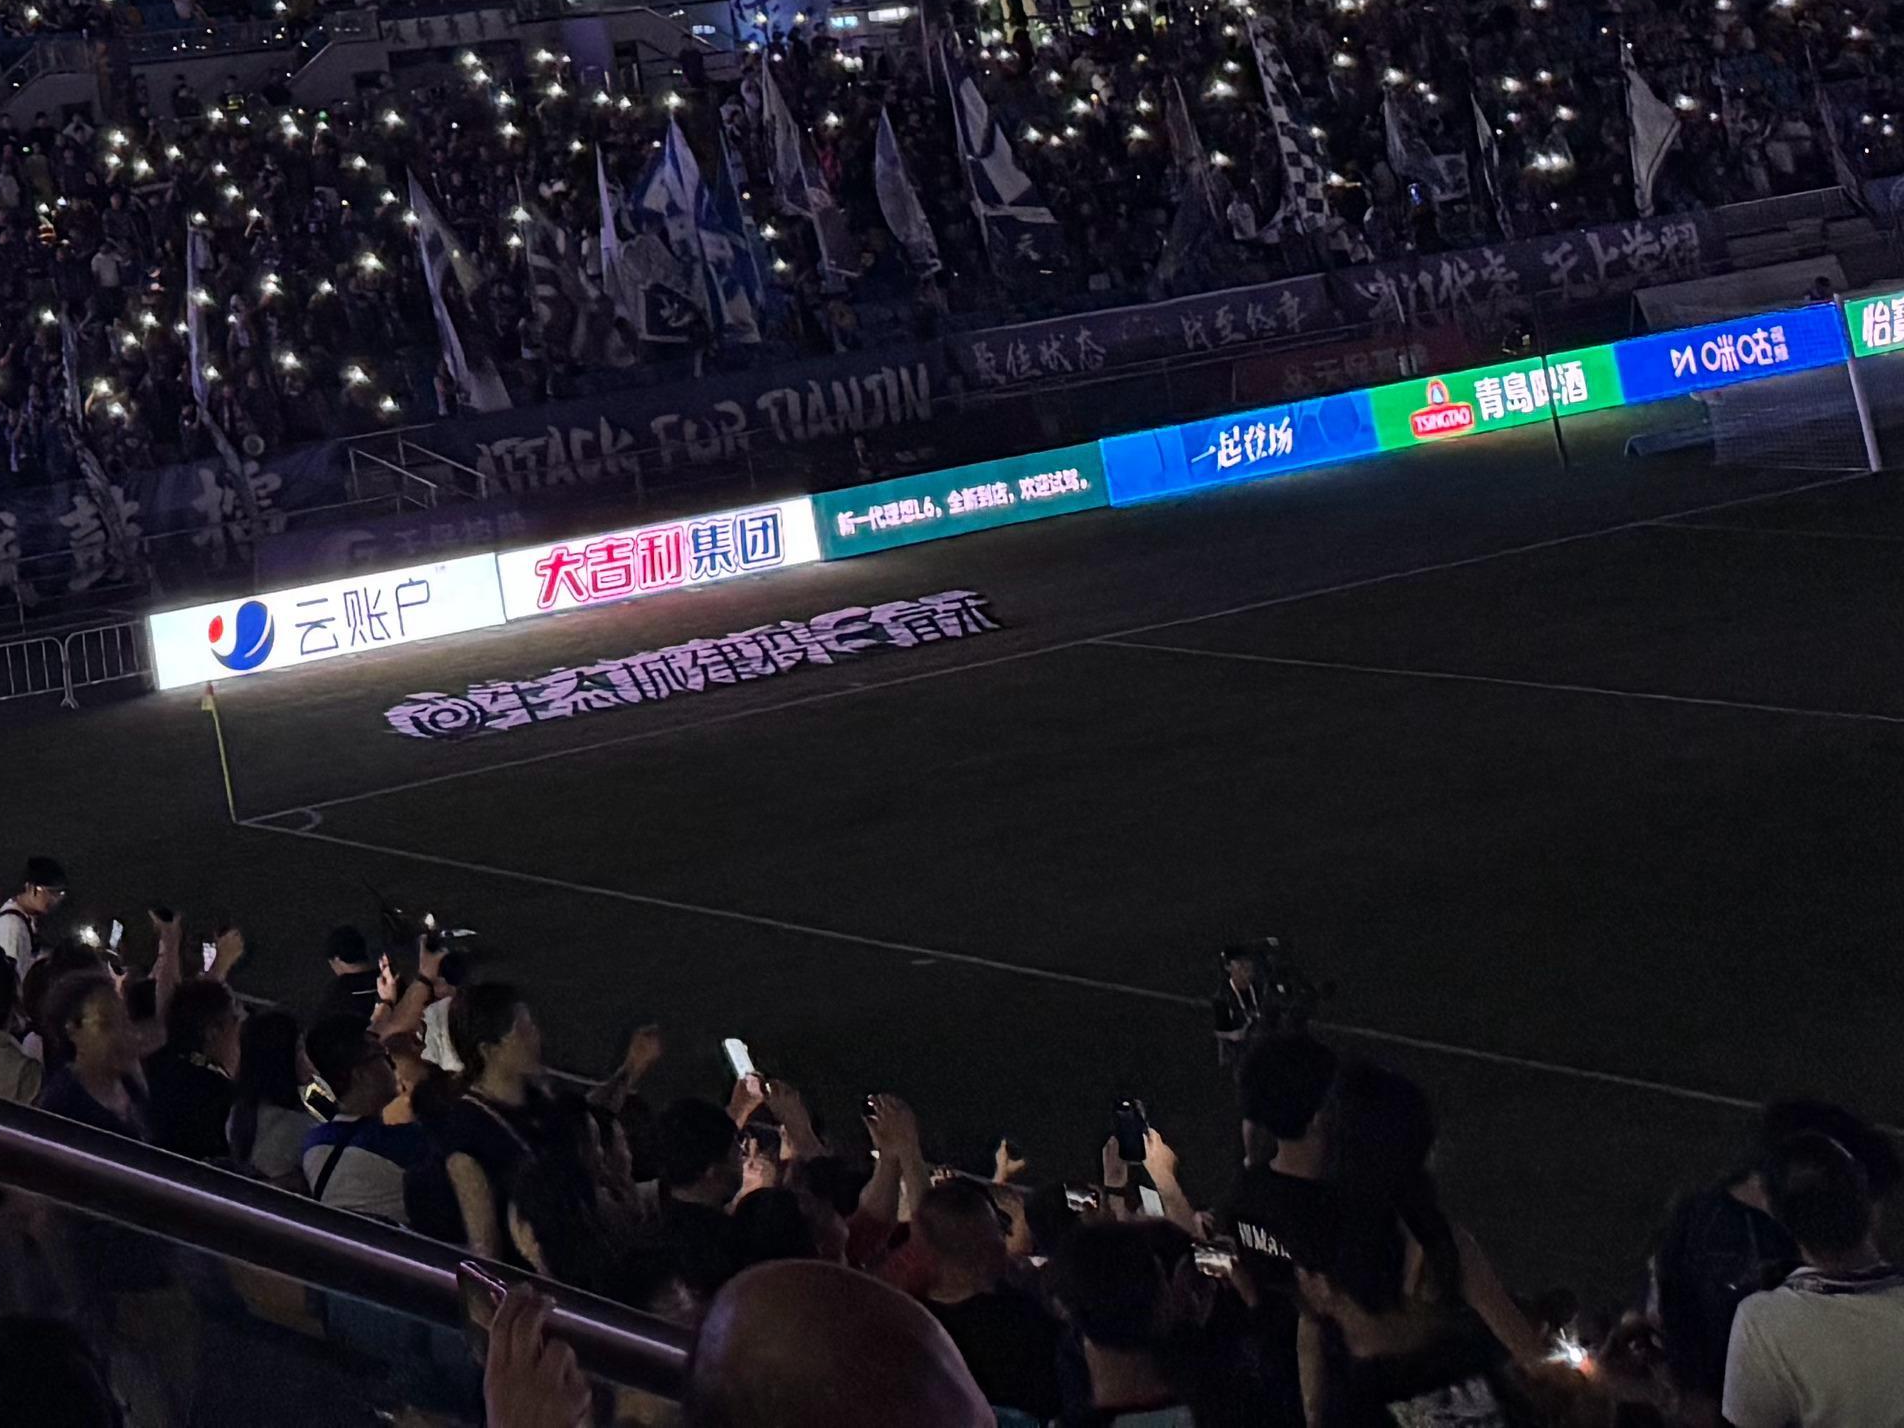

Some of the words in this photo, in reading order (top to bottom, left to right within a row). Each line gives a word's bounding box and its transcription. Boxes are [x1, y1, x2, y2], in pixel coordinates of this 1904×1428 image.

[650, 401, 751, 466] FOR
[758, 363, 932, 443] TIANJIN
[1414, 409, 1470, 433] TSINGTAO
[1474, 361, 1588, 421] 青岛啤酒
[537, 506, 784, 610] 大吉利集团
[297, 578, 430, 655] 云账户
